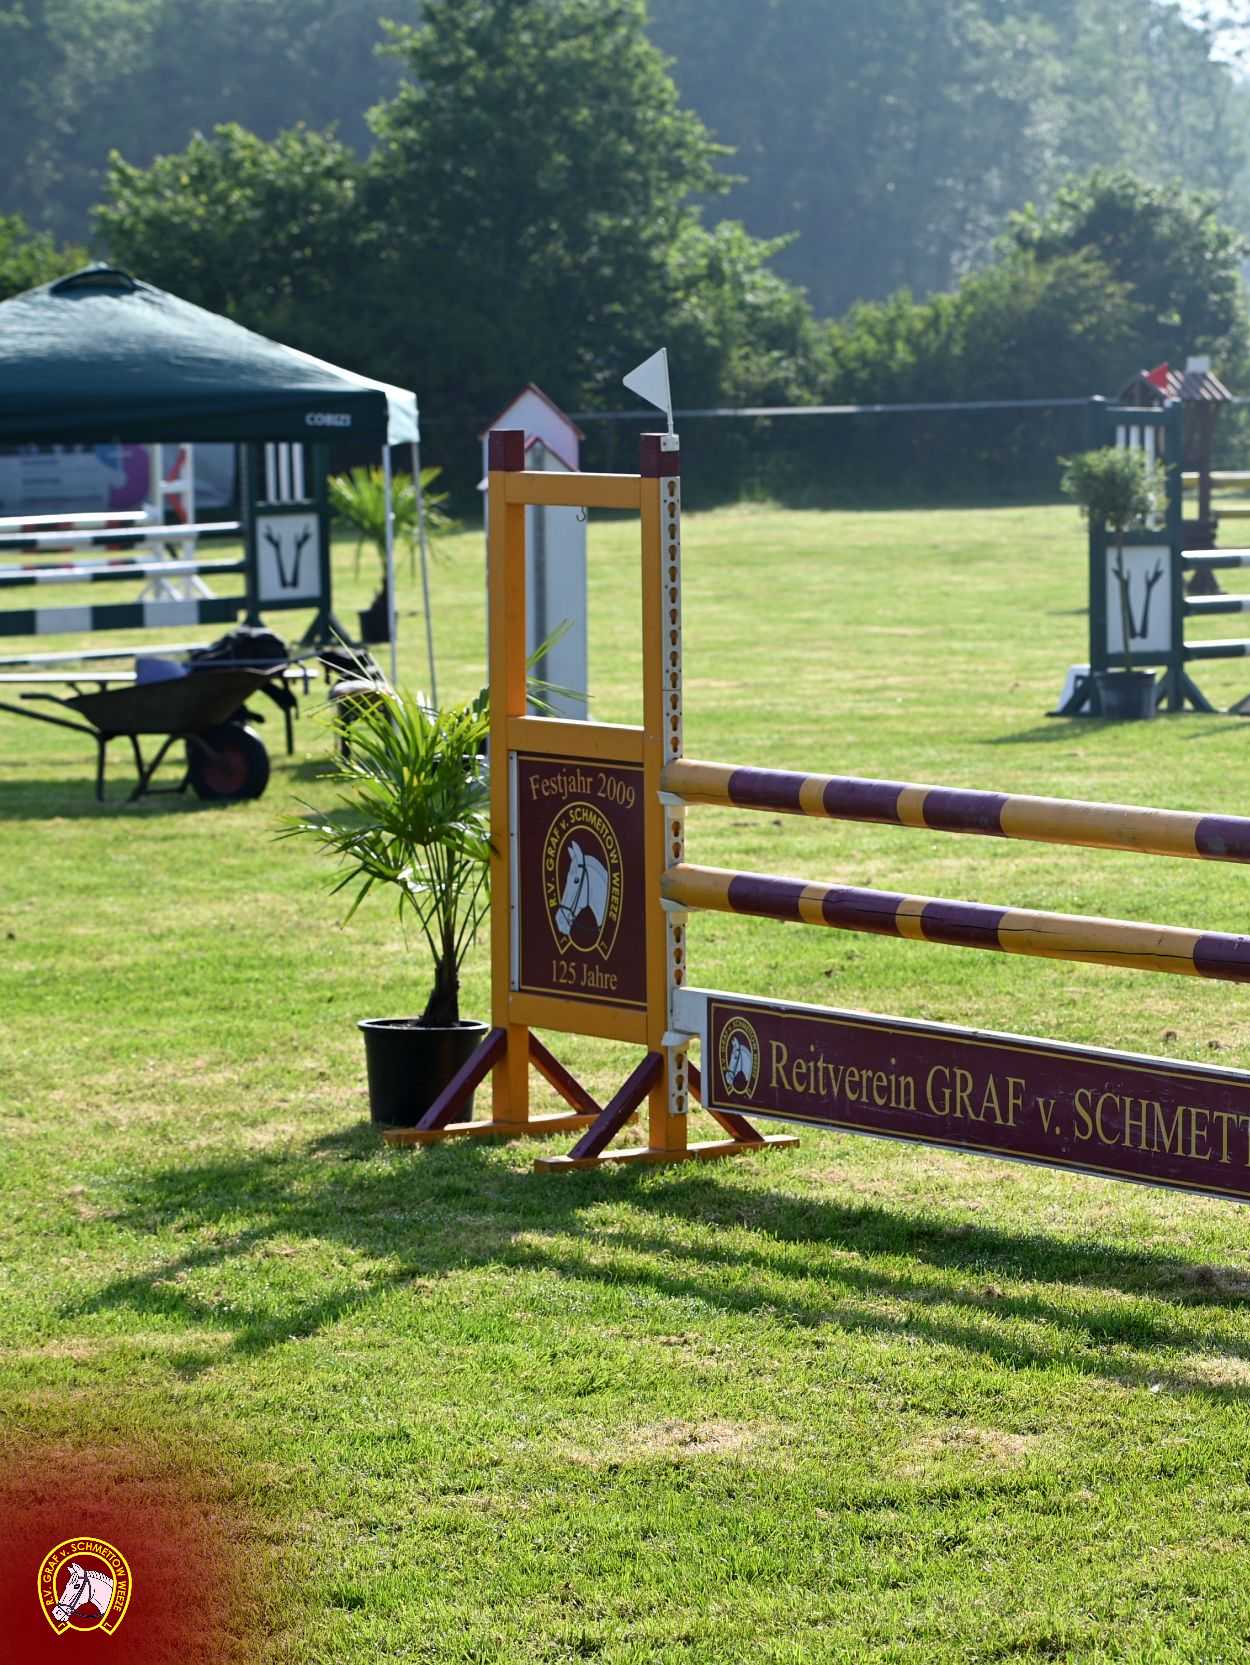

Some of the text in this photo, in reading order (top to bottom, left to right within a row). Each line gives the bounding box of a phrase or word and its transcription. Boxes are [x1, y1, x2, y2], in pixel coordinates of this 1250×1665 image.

[529, 768, 635, 809] Festjahr 2009
[546, 827, 560, 871] GRAF
[569, 807, 619, 864] SCHMETTOW
[608, 872, 621, 922] WEEZE
[551, 959, 618, 990] 125 Jahre
[769, 1039, 916, 1111] Reitverein
[926, 1064, 1026, 1127] GRAF
[1037, 1096, 1062, 1136] v.
